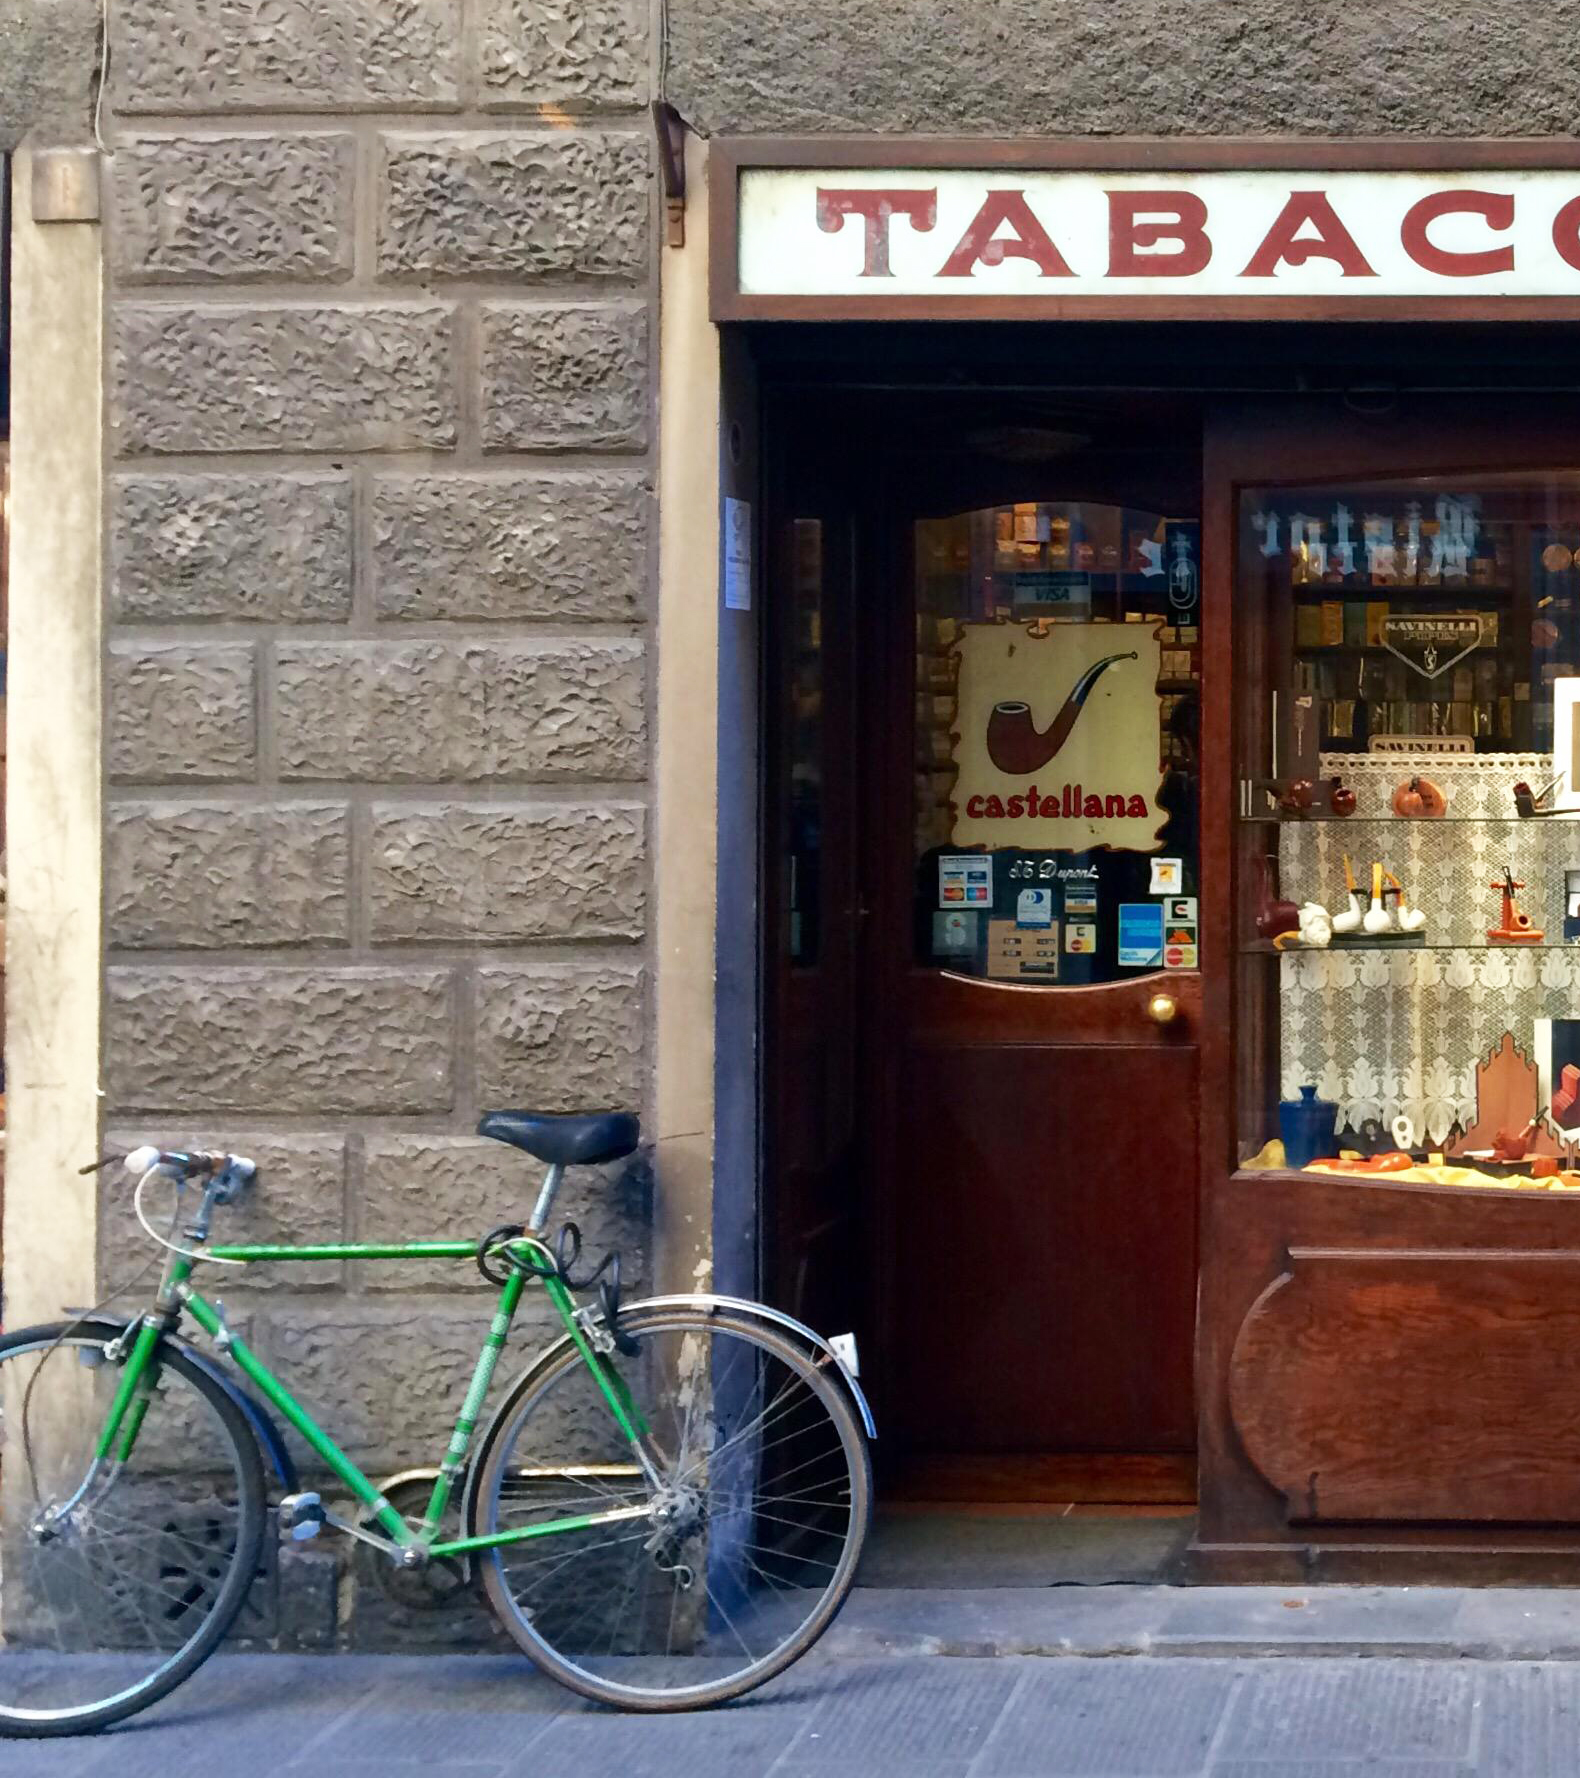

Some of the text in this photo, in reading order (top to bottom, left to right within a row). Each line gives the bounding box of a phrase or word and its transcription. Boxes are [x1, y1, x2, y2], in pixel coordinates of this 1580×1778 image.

[1035, 587, 1070, 601] VISA
[1385, 621, 1476, 631] SAVINELLI
[1375, 742, 1465, 752] SAVINELLI
[966, 784, 1149, 818] castellana
[1039, 859, 1100, 882] Dupont
